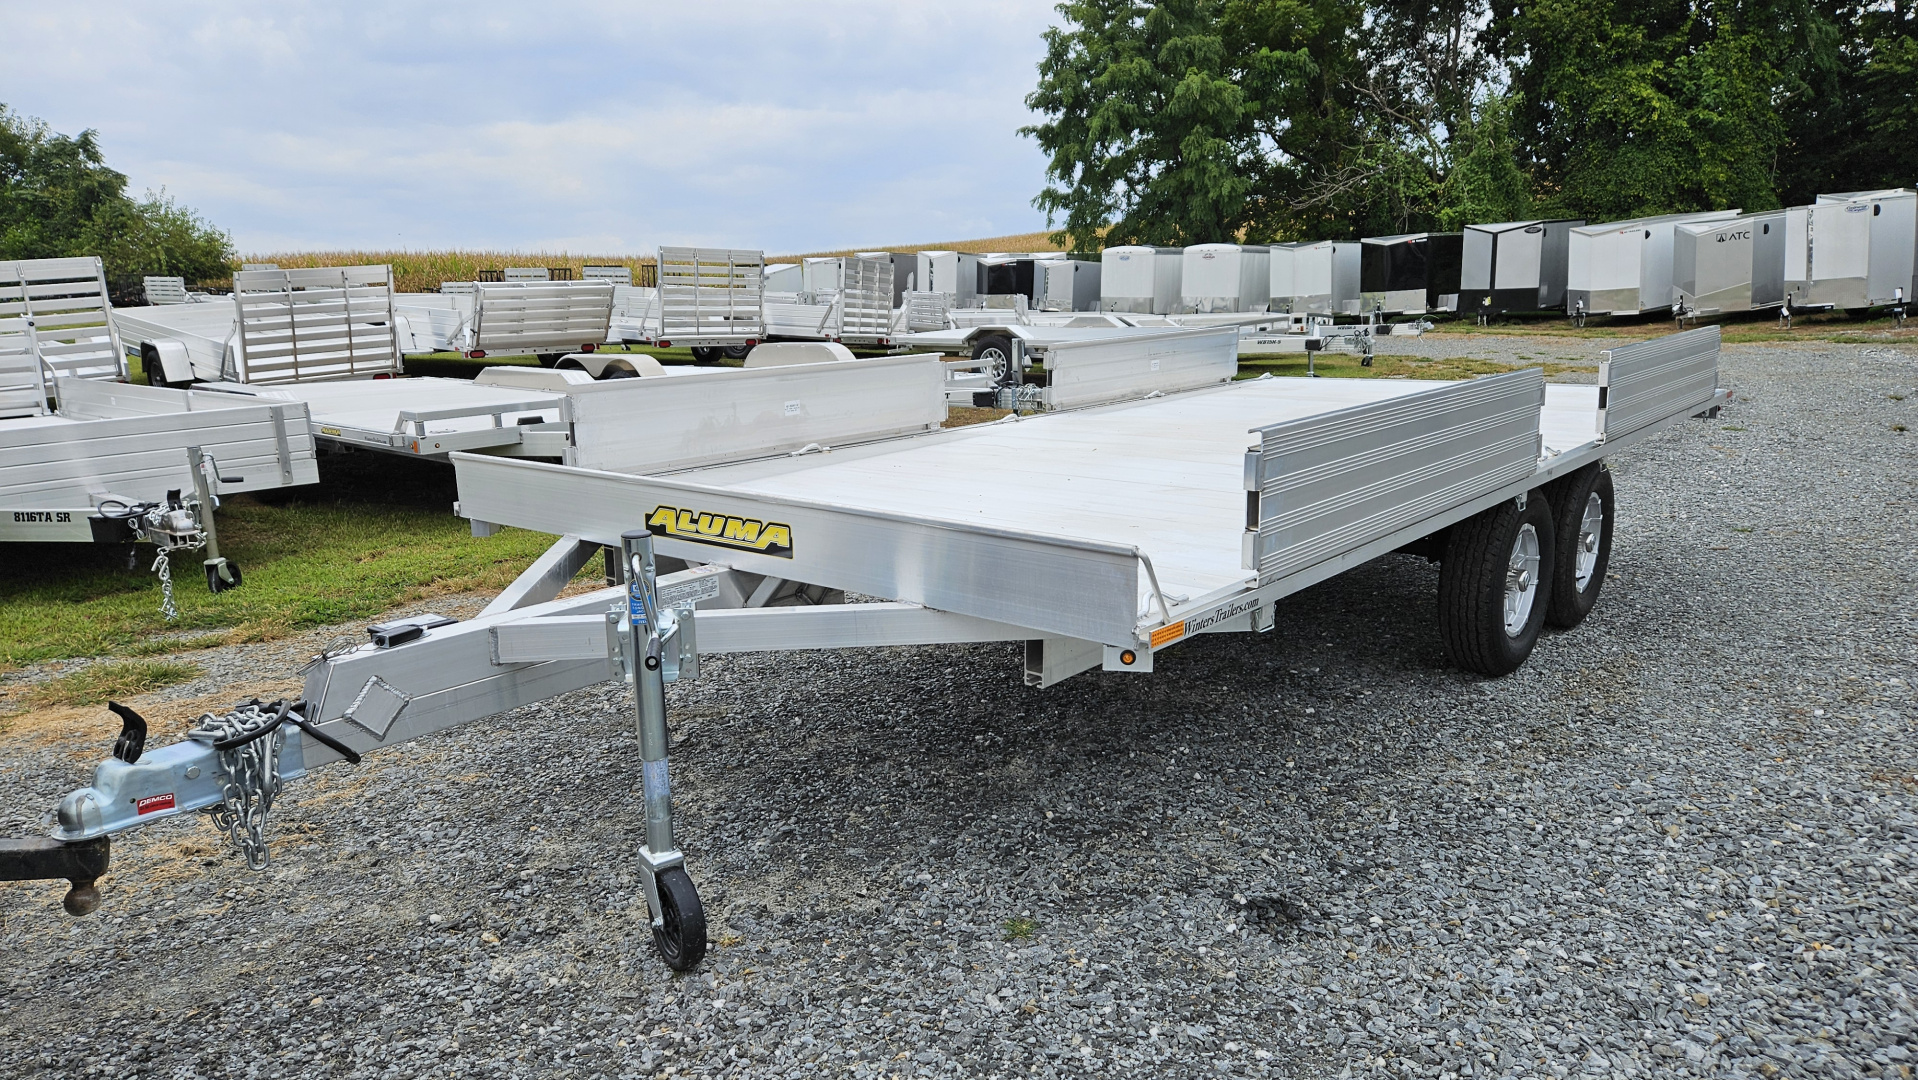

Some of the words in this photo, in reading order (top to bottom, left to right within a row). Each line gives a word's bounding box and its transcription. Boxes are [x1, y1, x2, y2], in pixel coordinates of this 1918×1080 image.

[1728, 231, 1751, 241] ATC
[13, 511, 53, 523] 8116TA
[56, 511, 72, 523] SR
[648, 507, 790, 550] ALUMA
[1184, 598, 1259, 636] WintersTrailers.com
[139, 794, 173, 807] DEMCO
